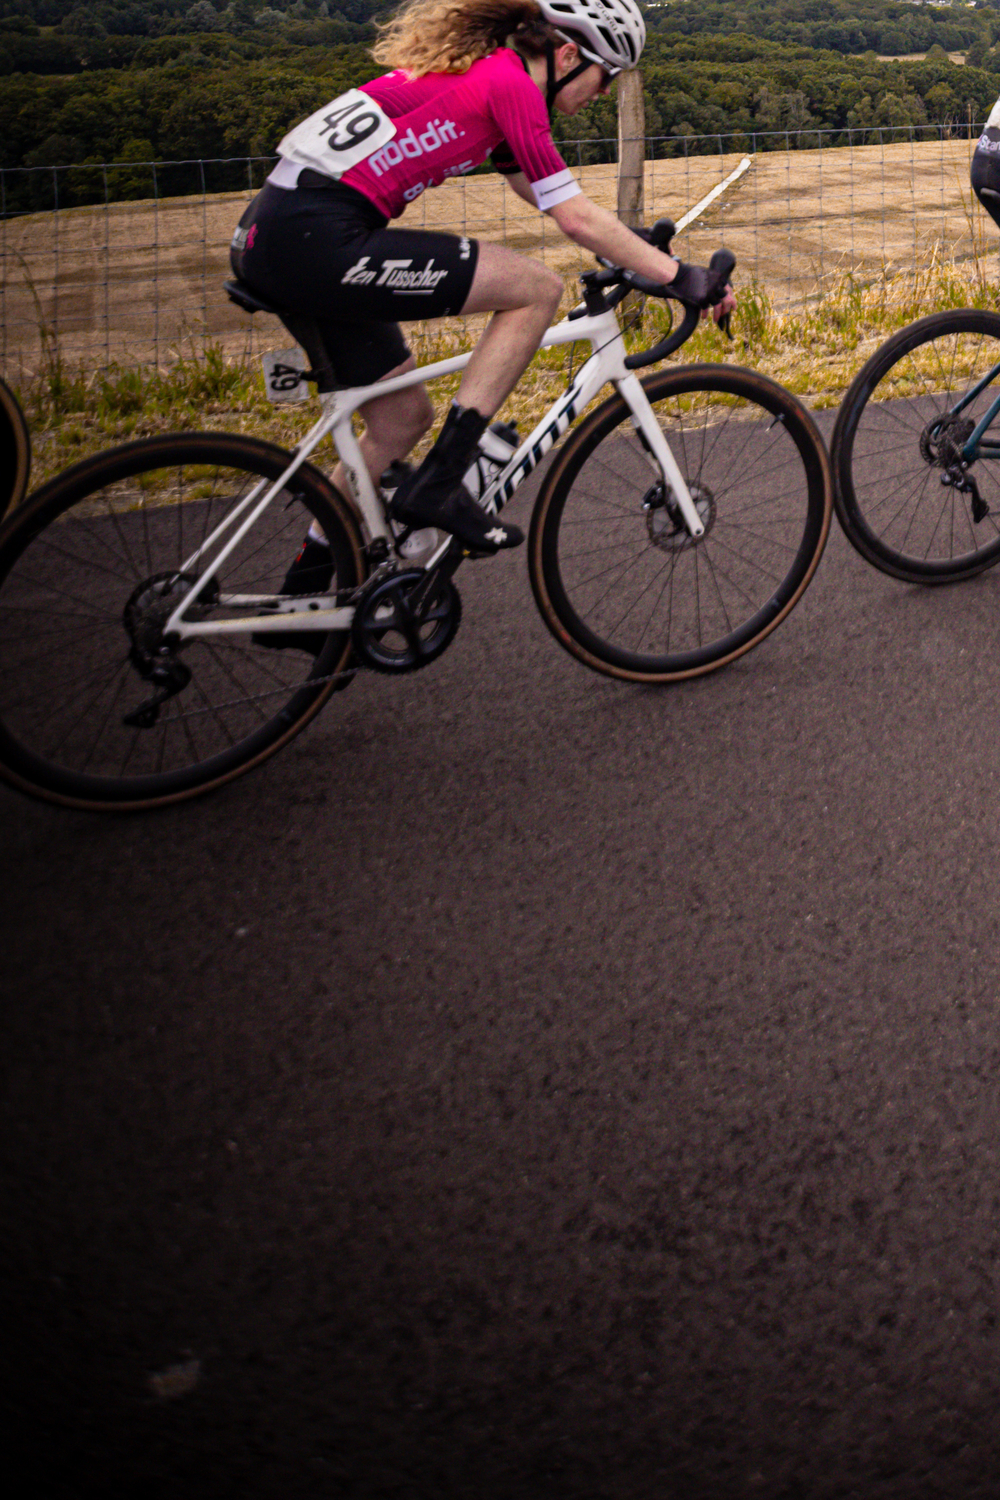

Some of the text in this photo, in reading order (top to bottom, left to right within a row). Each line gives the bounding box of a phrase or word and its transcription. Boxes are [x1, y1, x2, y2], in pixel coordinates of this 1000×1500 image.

[319, 100, 381, 152] 49
[375, 258, 448, 288] Tusscher
[269, 363, 301, 392] 49
